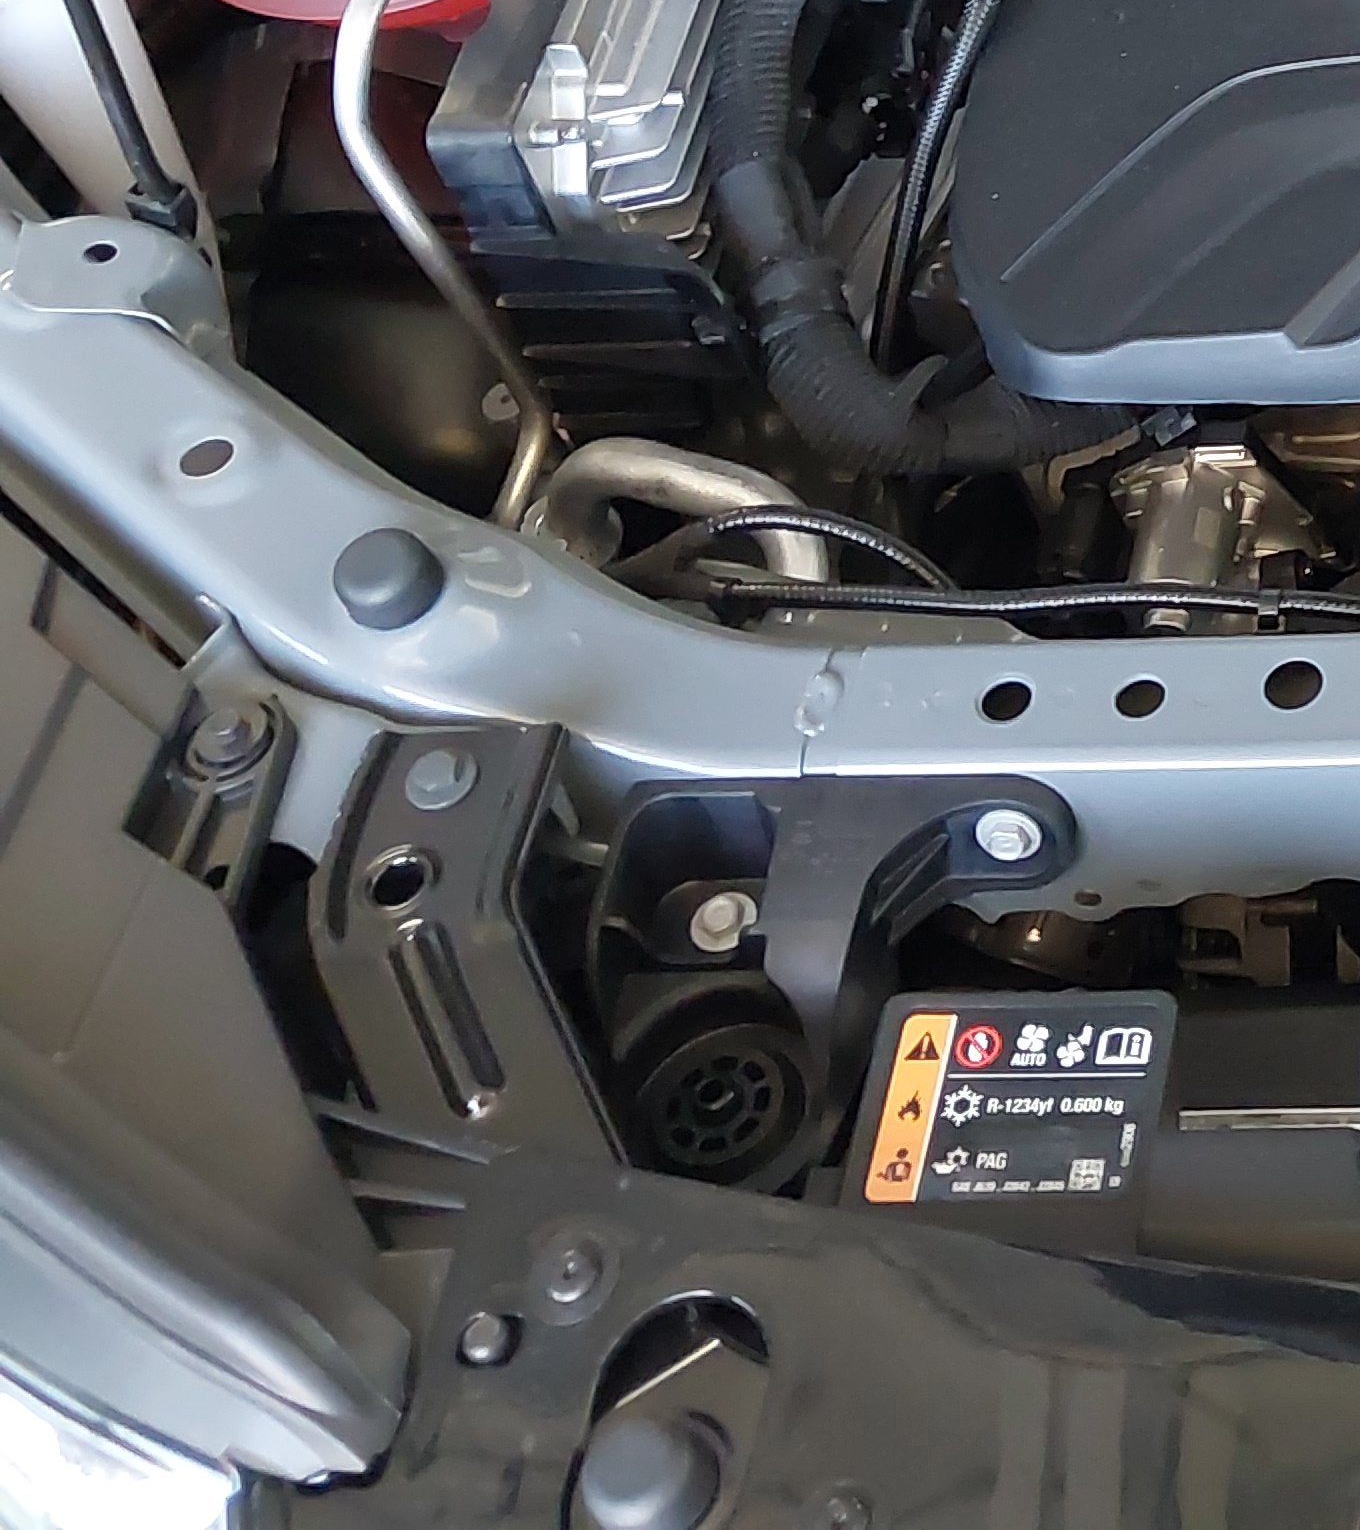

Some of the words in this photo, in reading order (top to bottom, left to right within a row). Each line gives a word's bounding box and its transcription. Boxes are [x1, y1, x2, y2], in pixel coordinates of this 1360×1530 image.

[1009, 1052, 1048, 1067] AUTO
[986, 1097, 1055, 1117] R-1234yf
[1060, 1097, 1102, 1112] 0.600
[1104, 1096, 1125, 1116] kg
[975, 1151, 1009, 1170] PAG
